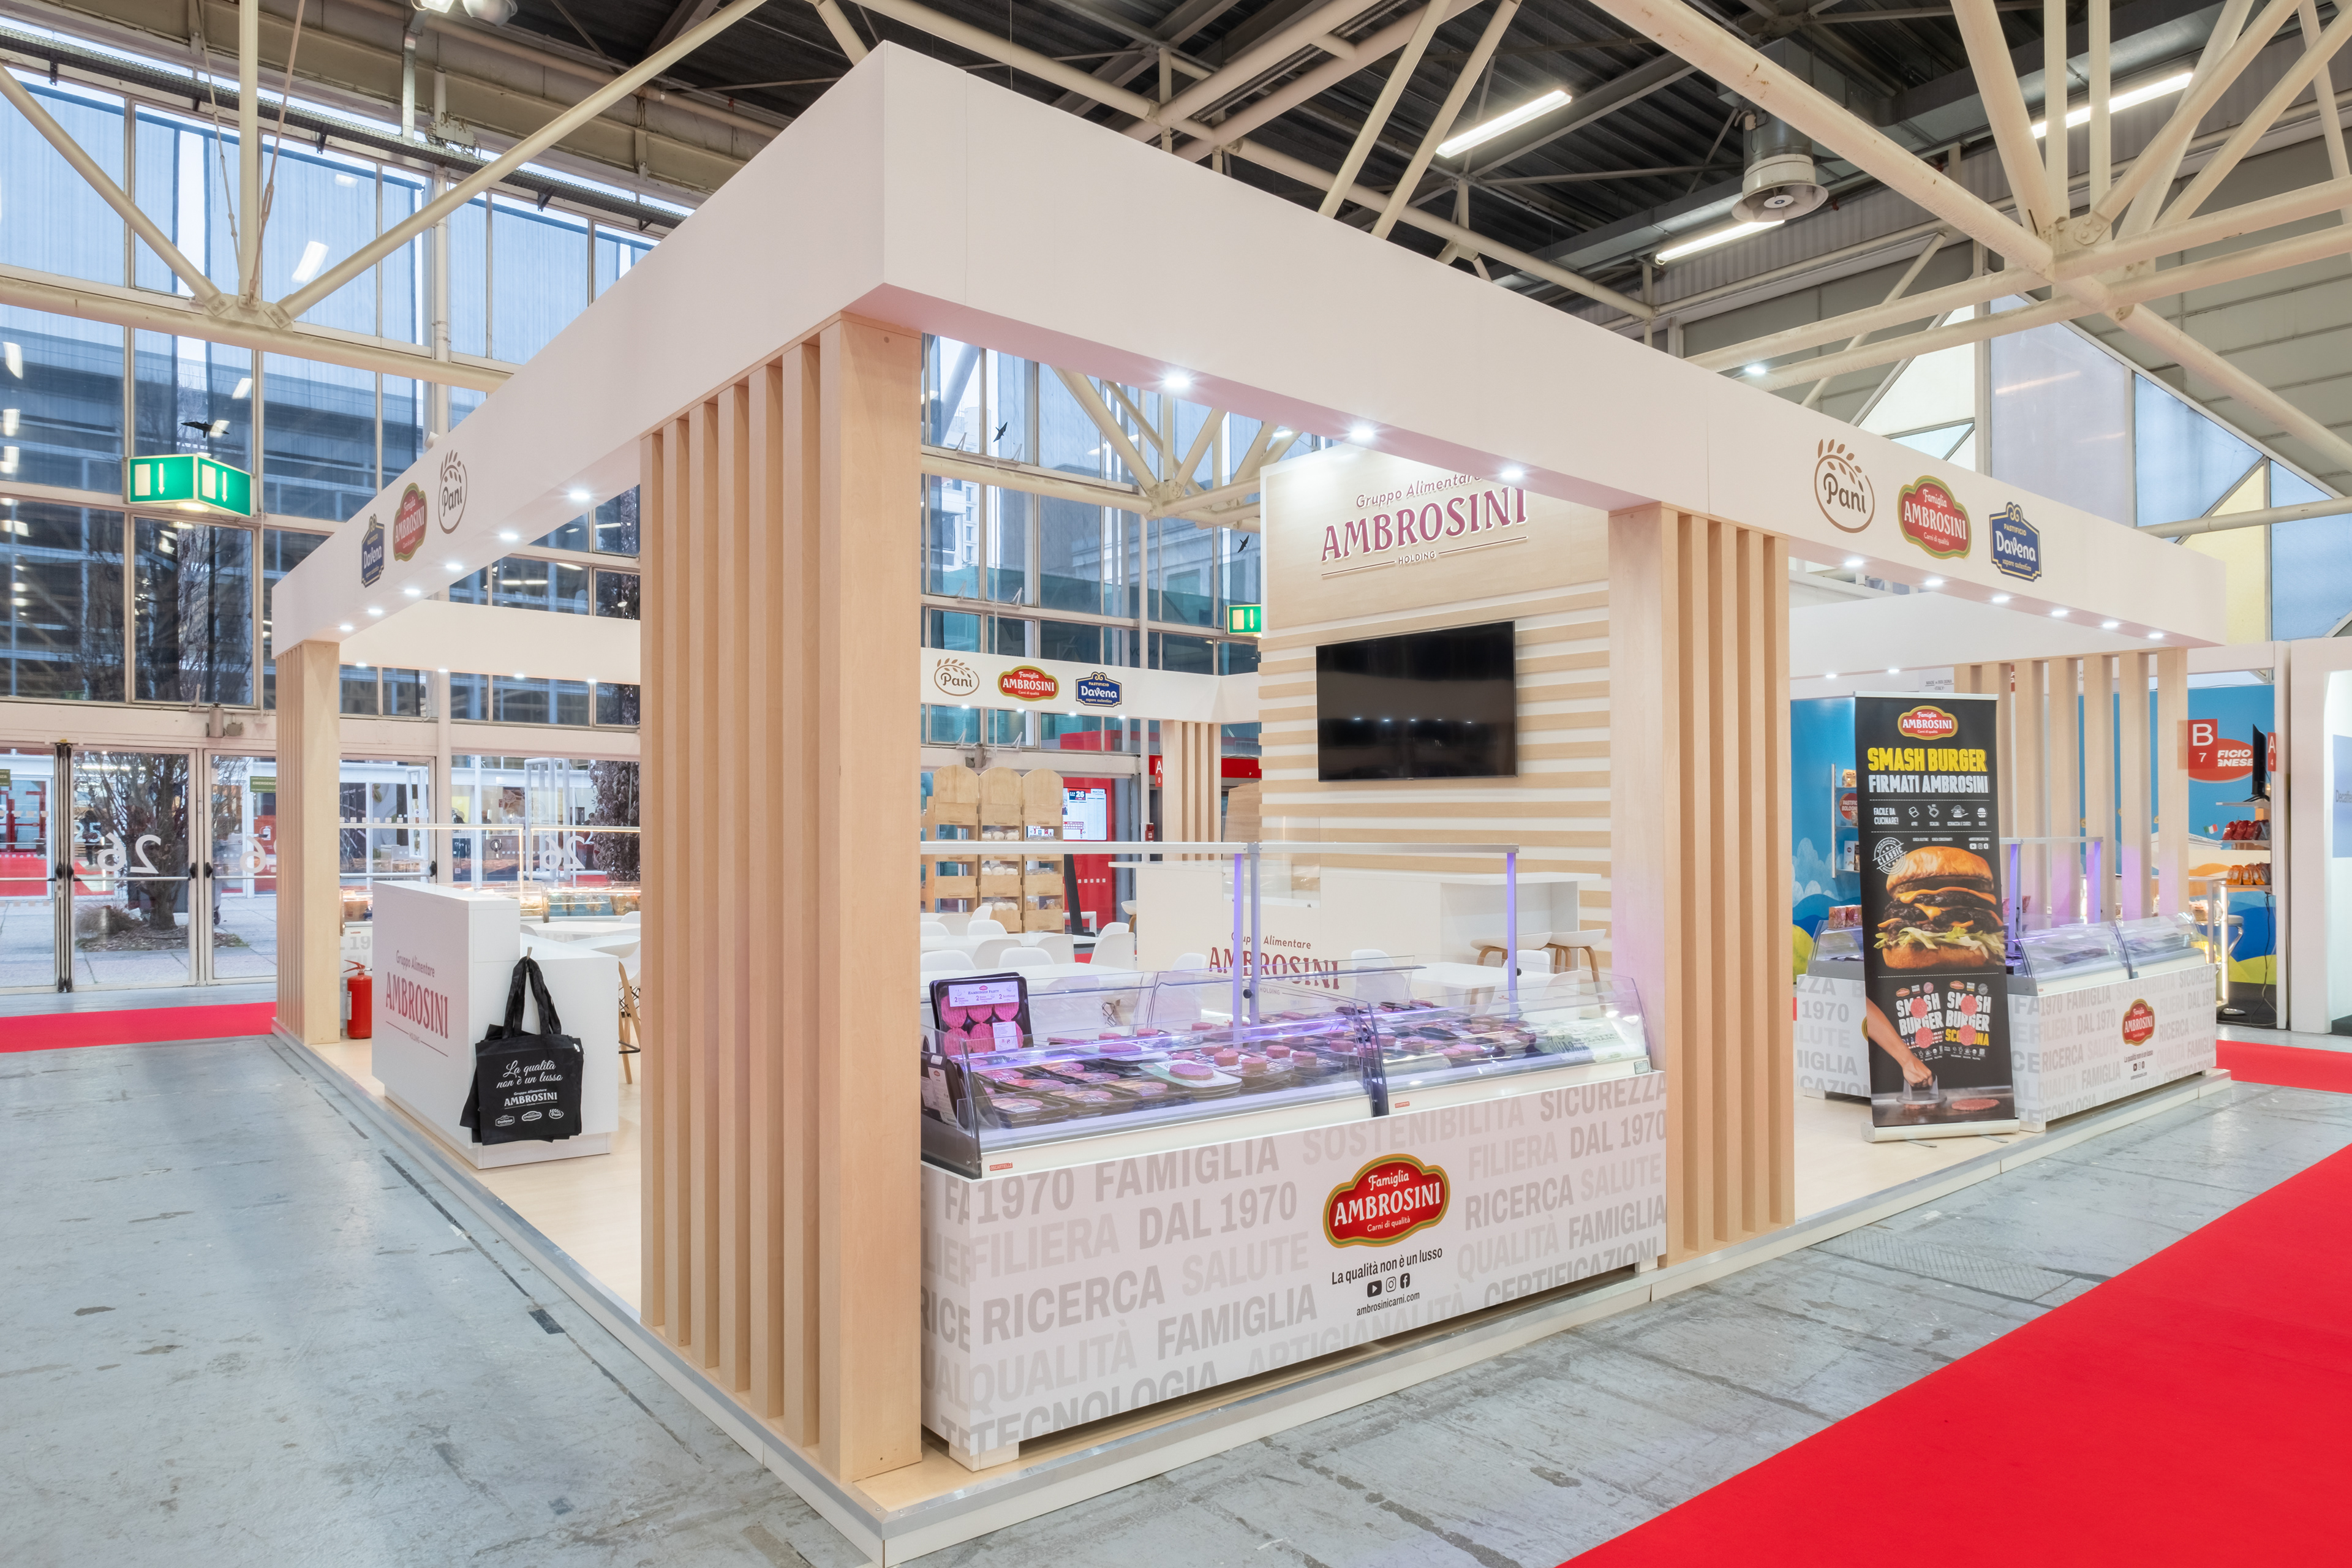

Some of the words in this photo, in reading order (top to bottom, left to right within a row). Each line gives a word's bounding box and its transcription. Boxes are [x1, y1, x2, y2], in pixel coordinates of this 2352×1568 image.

[442, 486, 462, 517] Pani
[1357, 489, 1401, 508] Gruppo
[1823, 472, 1866, 514] Pani
[1923, 489, 1947, 508] Famiglia
[394, 505, 424, 544] AMBROSINI
[1322, 486, 1527, 562] AMBROSINI
[1904, 501, 1966, 540] AMBROSINI
[2004, 523, 2027, 536] PASTIFICIO
[1938, 536, 1950, 546] qualità
[1398, 551, 1435, 565] HOLDING
[941, 673, 973, 688] Pani
[1003, 678, 1055, 692] AMBROSINI
[1902, 719, 1953, 729] AMBROSINI
[2193, 723, 2214, 746] B
[2268, 736, 2275, 753] A
[1156, 760, 1163, 774] A
[1868, 747, 1926, 771] SMASH
[1928, 748, 1988, 772] BURGER
[2199, 753, 2207, 763] 7
[1868, 775, 1920, 793] FIRMATI
[1922, 775, 1989, 793] AMBROSINI
[1874, 816, 1899, 825] CUCINARE!
[75, 822, 101, 842] 25
[1877, 839, 1897, 853] AMERICAN
[1877, 846, 1904, 865] CLASSIC
[1264, 935, 1311, 949] Alimentare
[396, 950, 411, 970] Gruppo
[412, 956, 435, 978] Alimentare
[385, 971, 448, 1039] AMBROSINI
[1802, 1000, 1849, 1022] 1970
[1896, 992, 1941, 1017] SMSH
[1947, 992, 1992, 1013] SMSH
[2041, 993, 2062, 1017] 1970
[2067, 984, 2111, 1011] FAMIGLIA
[1899, 1011, 1944, 1036] BURGER
[1946, 1010, 1990, 1031] BURGER
[2040, 1016, 2073, 1042] FILIERA
[2077, 1013, 2095, 1035] DAL
[2097, 1008, 2116, 1033] 1970
[2160, 994, 2185, 1017] FILIERA
[2188, 991, 2200, 1009] DAL
[2125, 1016, 2153, 1033] AMBROSINI
[409, 1031, 420, 1044] HOLDING
[2042, 1044, 2084, 1072] RICERCA
[2087, 1035, 2119, 1061] SALUTE
[2159, 1023, 2189, 1042] RICERCA
[503, 1060, 521, 1078] La
[523, 1060, 556, 1076] qualità
[517, 1076, 522, 1085] è
[540, 1072, 563, 1082] lusso
[2082, 1061, 2121, 1090] FAMIGLIA
[504, 1092, 557, 1106] AMBROSINI
[978, 1168, 1074, 1224] 1970
[1095, 1137, 1280, 1202] FAMIGLIA
[1368, 1169, 1409, 1191] Famiglia
[970, 1213, 1120, 1283] FILIERA
[1139, 1199, 1211, 1250] DAL
[1220, 1181, 1297, 1233] 1970
[1469, 1131, 1558, 1181] FILIERA
[1570, 1121, 1613, 1159] DAL
[1621, 1109, 1667, 1148] 1970
[1335, 1182, 1440, 1226] AMBROSINI
[1367, 1223, 1383, 1232] Carni
[1391, 1216, 1410, 1228] qualità
[983, 1265, 1165, 1345] RICERCA
[1182, 1231, 1308, 1296] SALUTE
[1465, 1174, 1574, 1231] RICERCA
[1581, 1153, 1662, 1201] SALUTE
[1332, 1272, 1343, 1284] La
[1346, 1261, 1378, 1283] qualità
[1381, 1259, 1397, 1273] non
[1399, 1255, 1404, 1267] è
[1406, 1254, 1417, 1266] un
[1419, 1248, 1442, 1263] lusso
[970, 1319, 1137, 1416] QUALITÀ
[1158, 1283, 1317, 1360] FAMIGLIA
[1457, 1214, 1559, 1283] QUALITÀ
[1569, 1195, 1667, 1250] FAMIGLIA
[1357, 1292, 1420, 1316] ambrosinicarni.com
